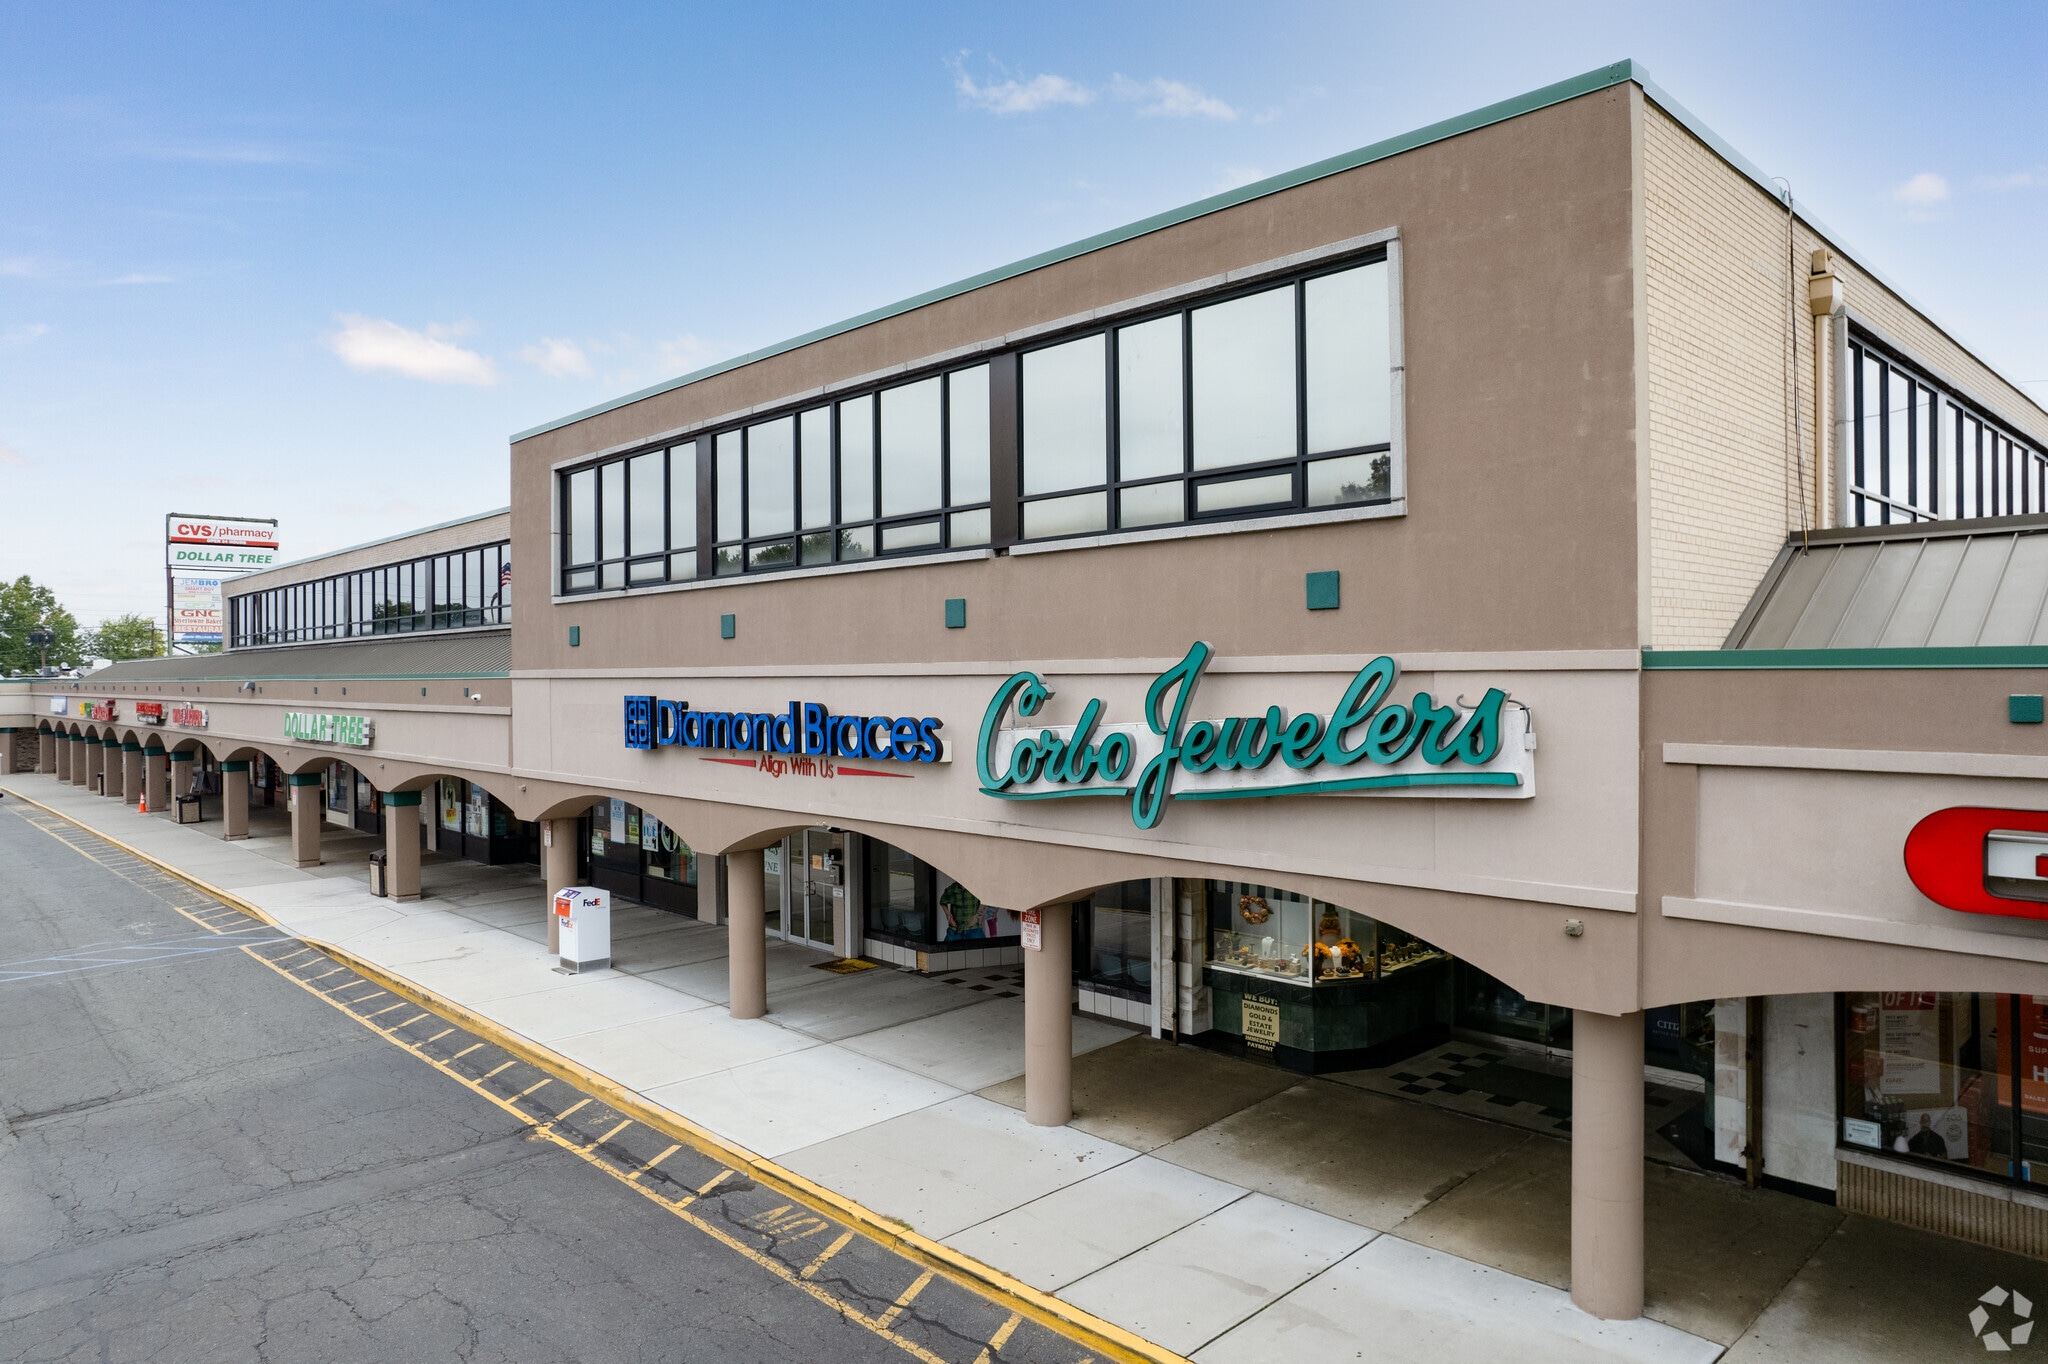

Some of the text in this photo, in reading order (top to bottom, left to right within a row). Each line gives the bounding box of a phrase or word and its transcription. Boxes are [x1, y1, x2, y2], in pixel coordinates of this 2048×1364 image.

[177, 524, 273, 539] CVS/pharmacy
[176, 551, 272, 564] DOLLAR TREE
[284, 712, 365, 745] DOLLAR TREE
[657, 700, 946, 763] Diamond Braces
[976, 640, 1506, 830] Corbo Jewelers
[759, 754, 834, 779] Align With Us
[1025, 914, 1038, 924] ZONE
[1244, 993, 1257, 1001] WE
[1243, 1003, 1278, 1015] DIAMONDS
[1249, 1013, 1266, 1021] GOLD
[1249, 1020, 1272, 1030] ESTATE
[1246, 1026, 1275, 1037] JEWELRY
[1247, 1041, 1274, 1052] PAYMENT
